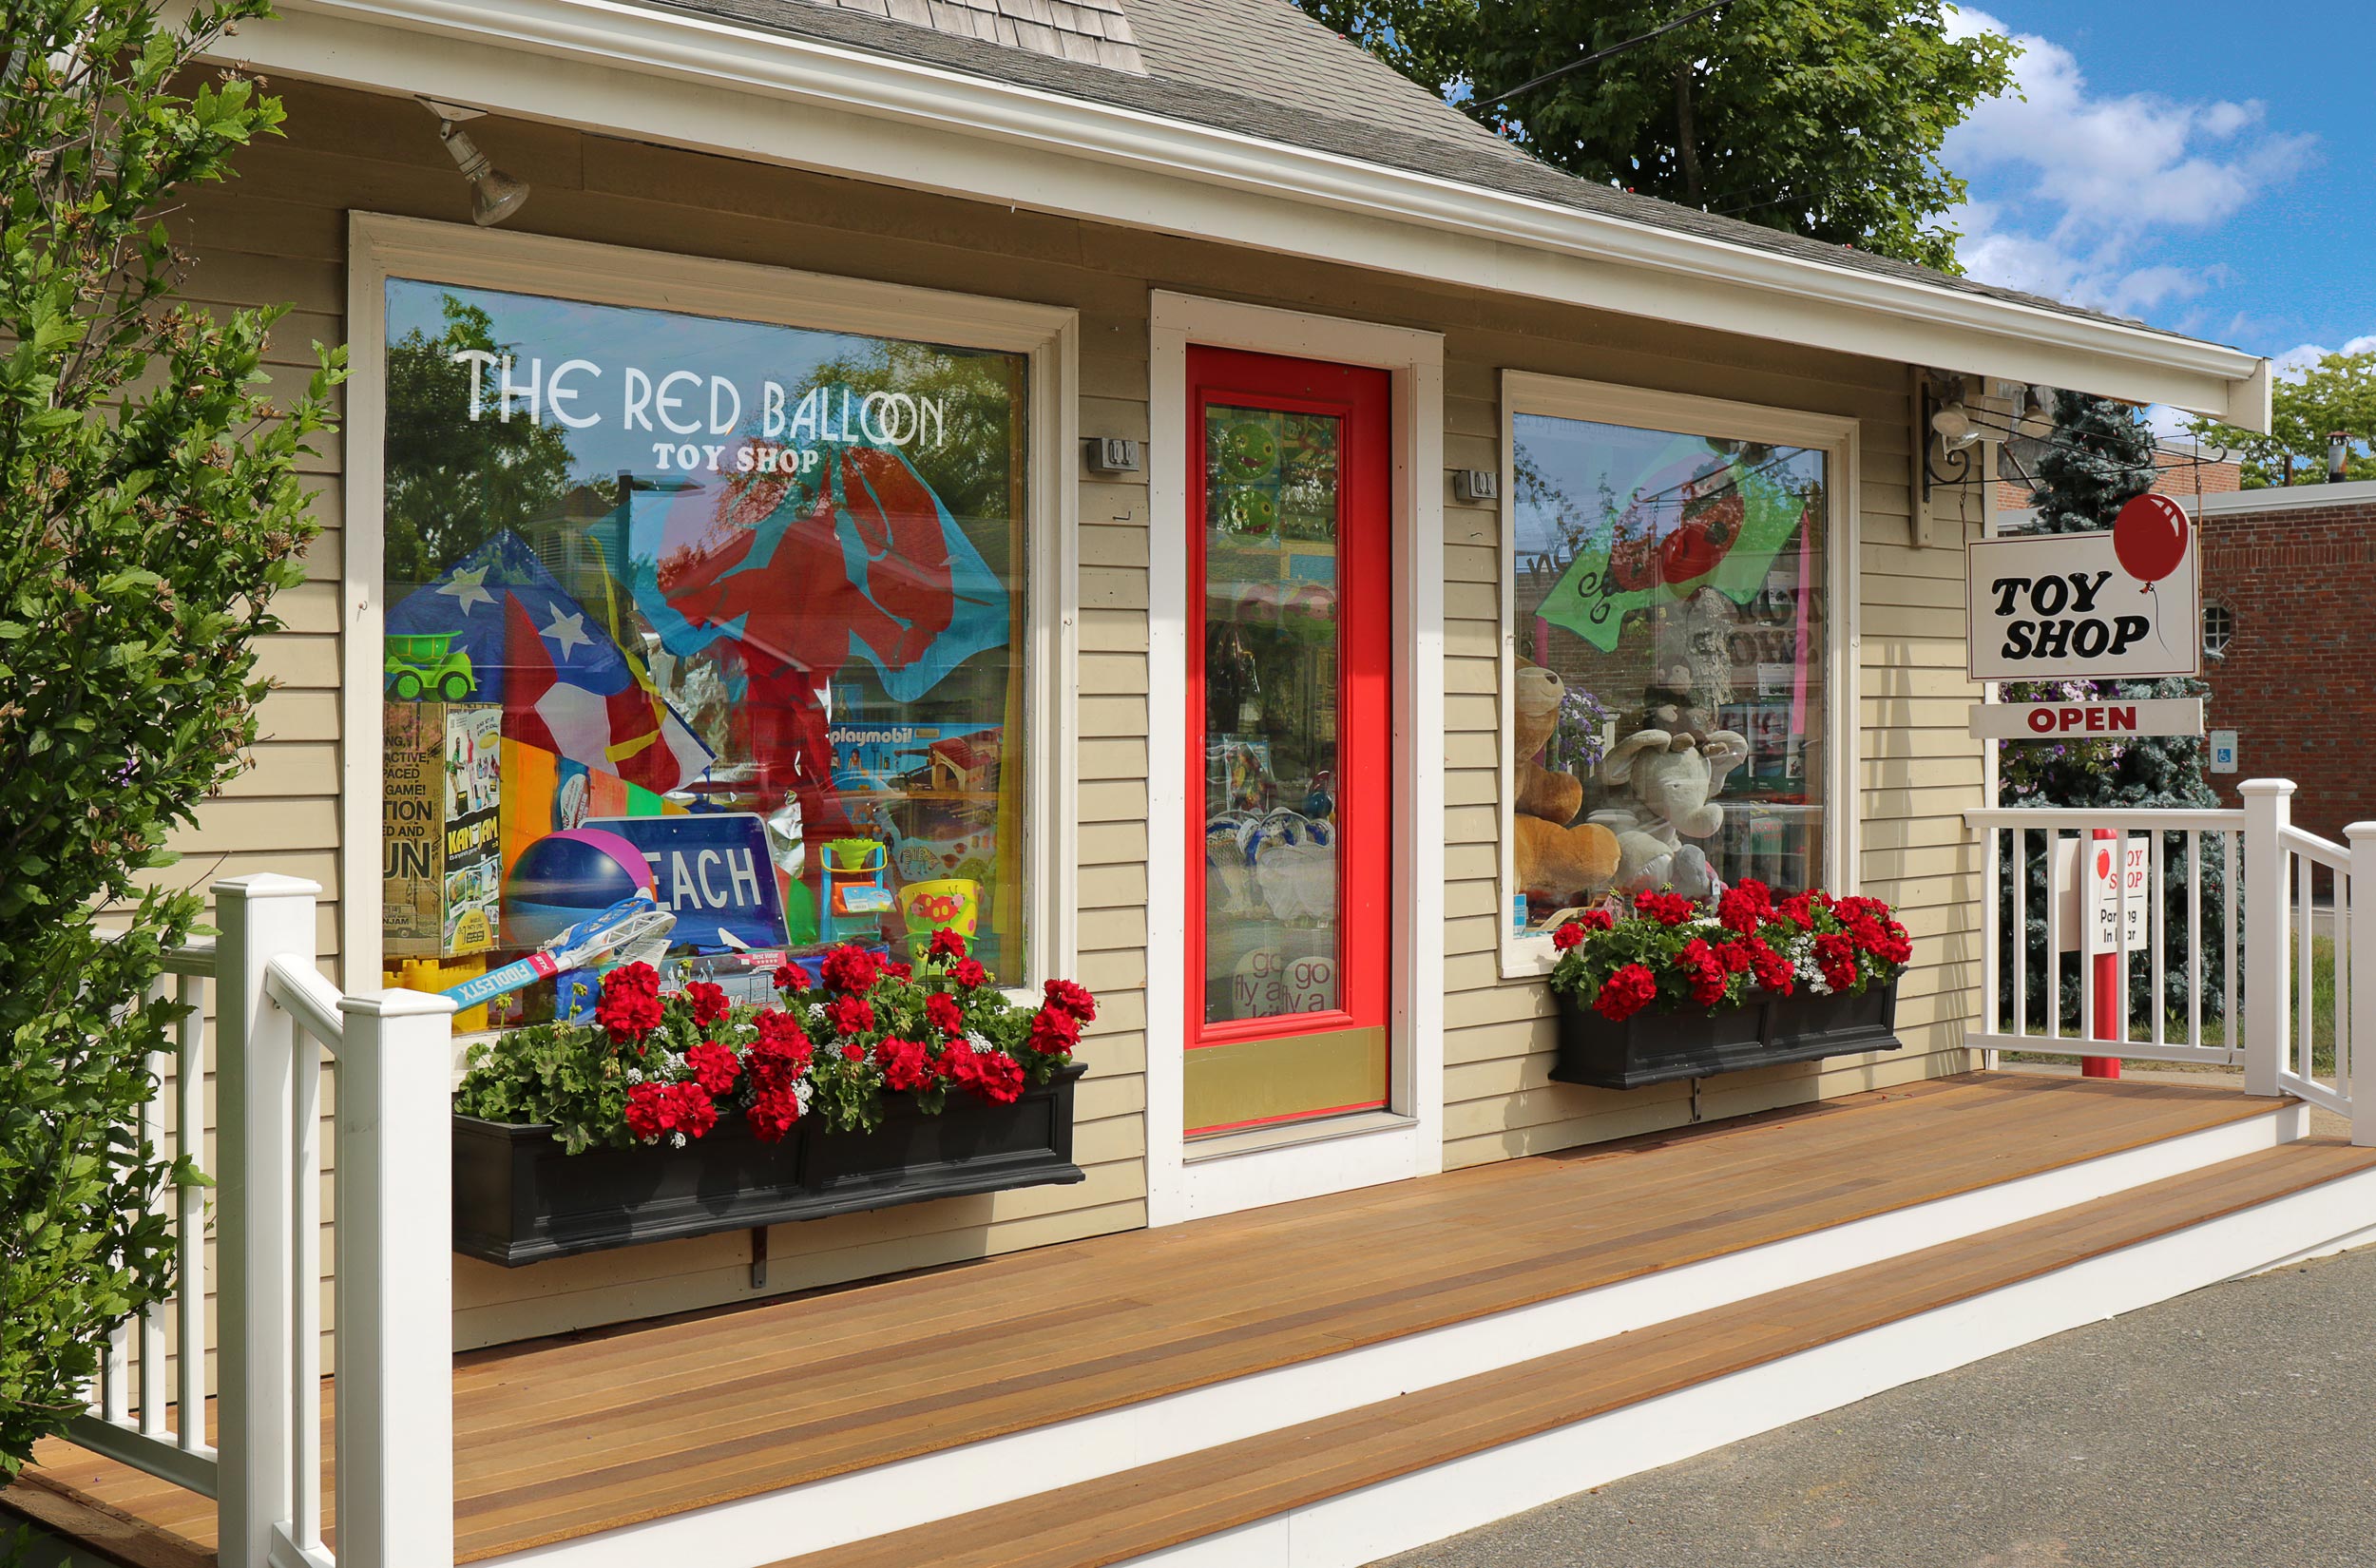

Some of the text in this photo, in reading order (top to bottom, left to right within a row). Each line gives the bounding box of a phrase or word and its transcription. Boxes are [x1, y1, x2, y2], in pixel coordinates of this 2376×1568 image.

[450, 349, 944, 448] THE RED BALLOON
[652, 442, 819, 474] TOY SHOP
[1991, 570, 2113, 617] TOY
[2001, 615, 2151, 660] SHOP
[2027, 706, 2137, 734] OPEN
[830, 727, 913, 748] playmobil
[385, 784, 426, 795] GAME!
[397, 825, 425, 837] AND
[641, 848, 762, 911] EACH
[2109, 871, 2143, 889] SOP
[2100, 908, 2136, 924] Parng
[2103, 928, 2112, 943] In
[458, 963, 531, 1002] FIDDLESTX
[1294, 963, 1331, 990] go
[1235, 974, 1281, 1007] fly a
[1308, 993, 1325, 1013] a
